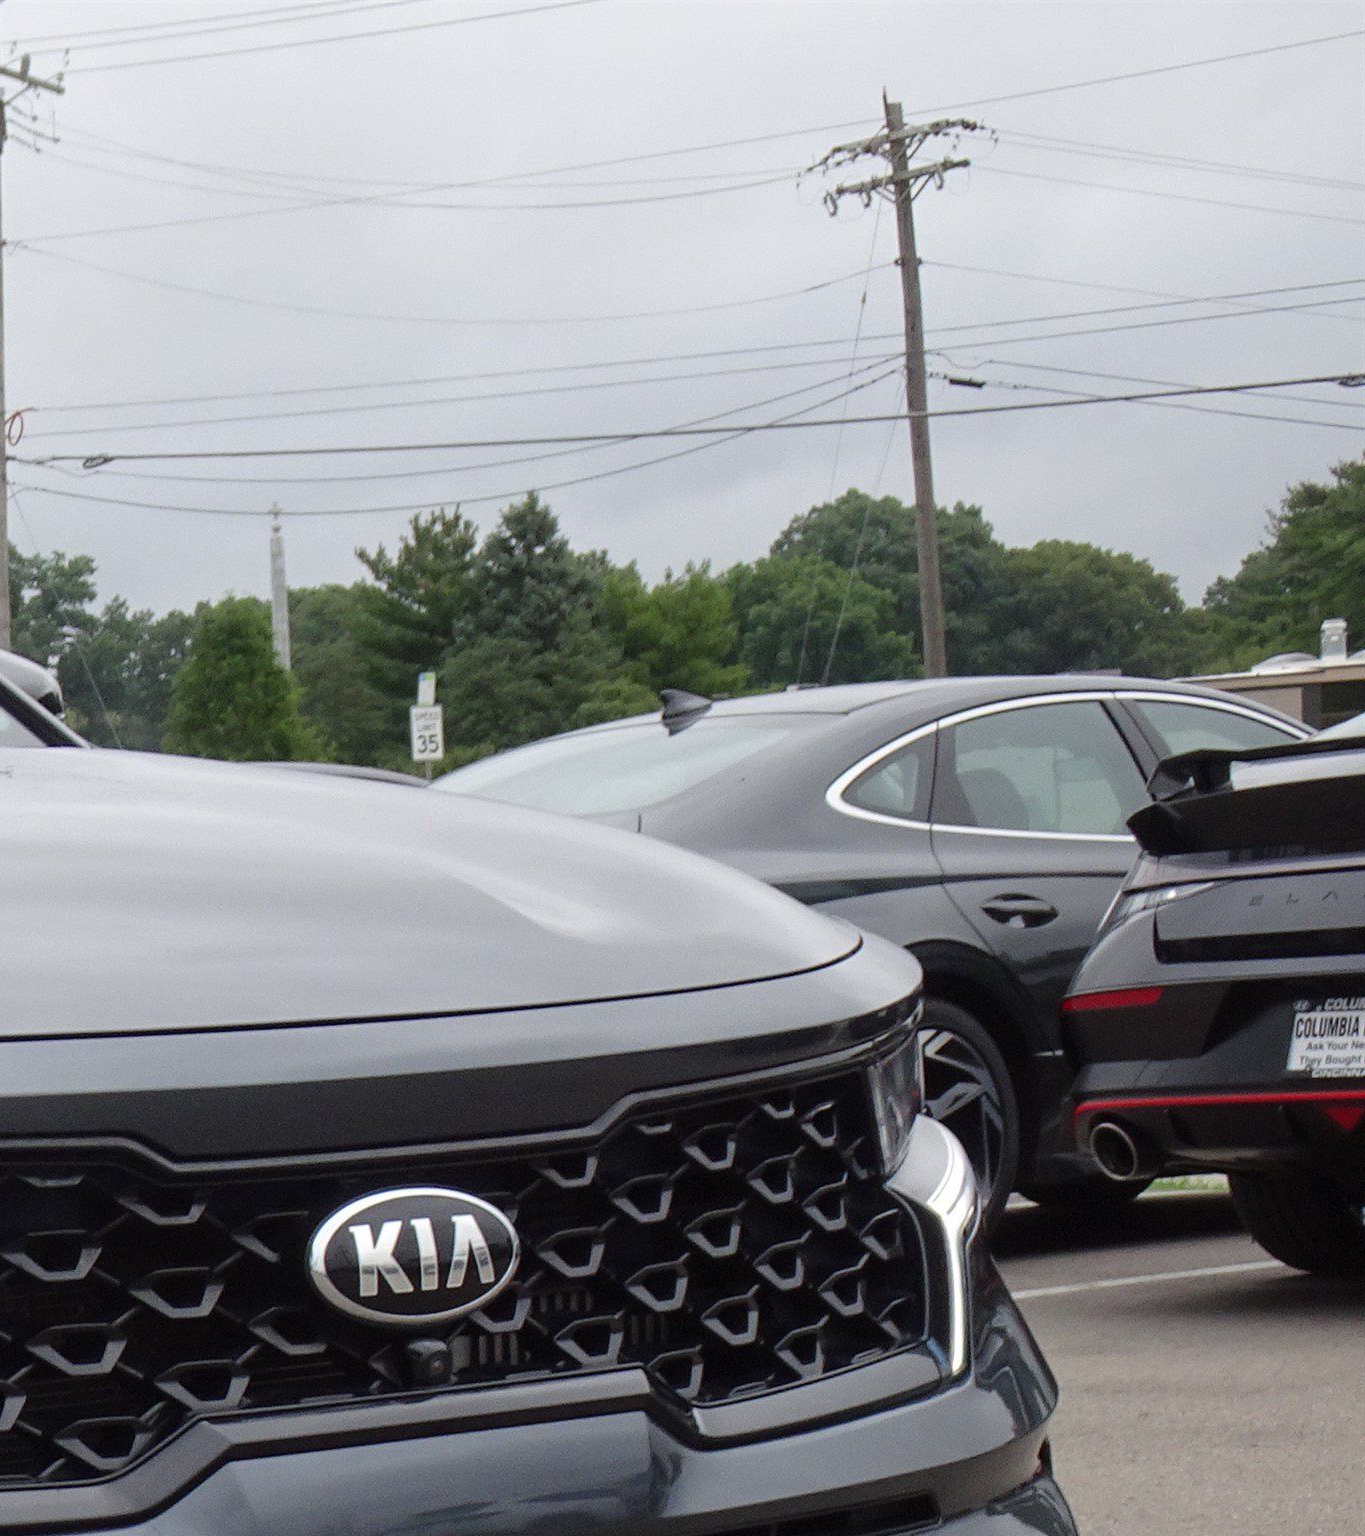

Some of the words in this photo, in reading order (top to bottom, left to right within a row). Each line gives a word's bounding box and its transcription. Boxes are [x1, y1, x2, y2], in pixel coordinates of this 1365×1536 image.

[417, 734, 439, 754] 35
[1295, 1016, 1360, 1038] COLUMBIA
[1327, 1040, 1349, 1051] Your
[1300, 1054, 1322, 1067] They
[1325, 1053, 1362, 1066] Bought
[349, 1214, 495, 1297] KIA
